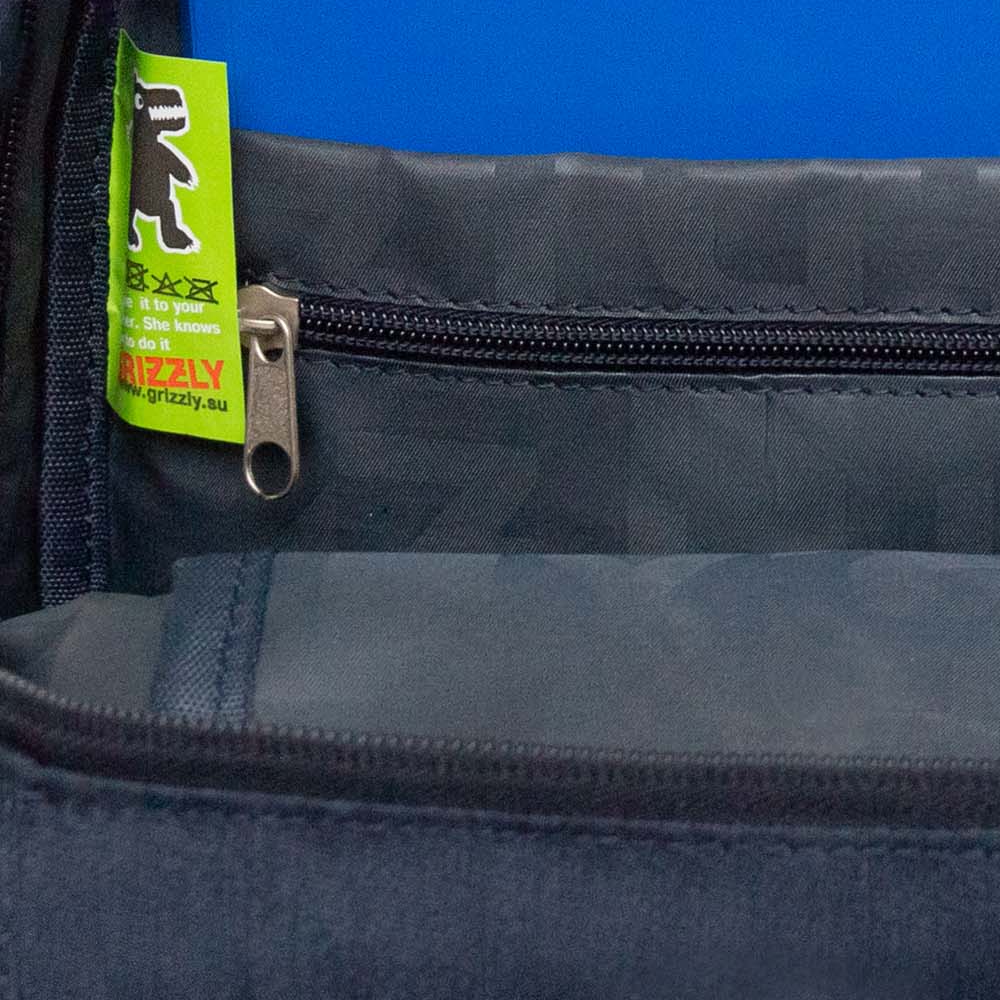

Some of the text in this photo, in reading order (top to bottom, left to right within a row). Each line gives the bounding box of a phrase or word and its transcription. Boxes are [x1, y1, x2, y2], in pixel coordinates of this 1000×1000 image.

[140, 296, 150, 311] it
[154, 297, 169, 312] to
[173, 301, 205, 316] your
[143, 316, 170, 332] She
[174, 319, 221, 335] knows
[138, 336, 156, 351] do
[159, 337, 171, 352] it
